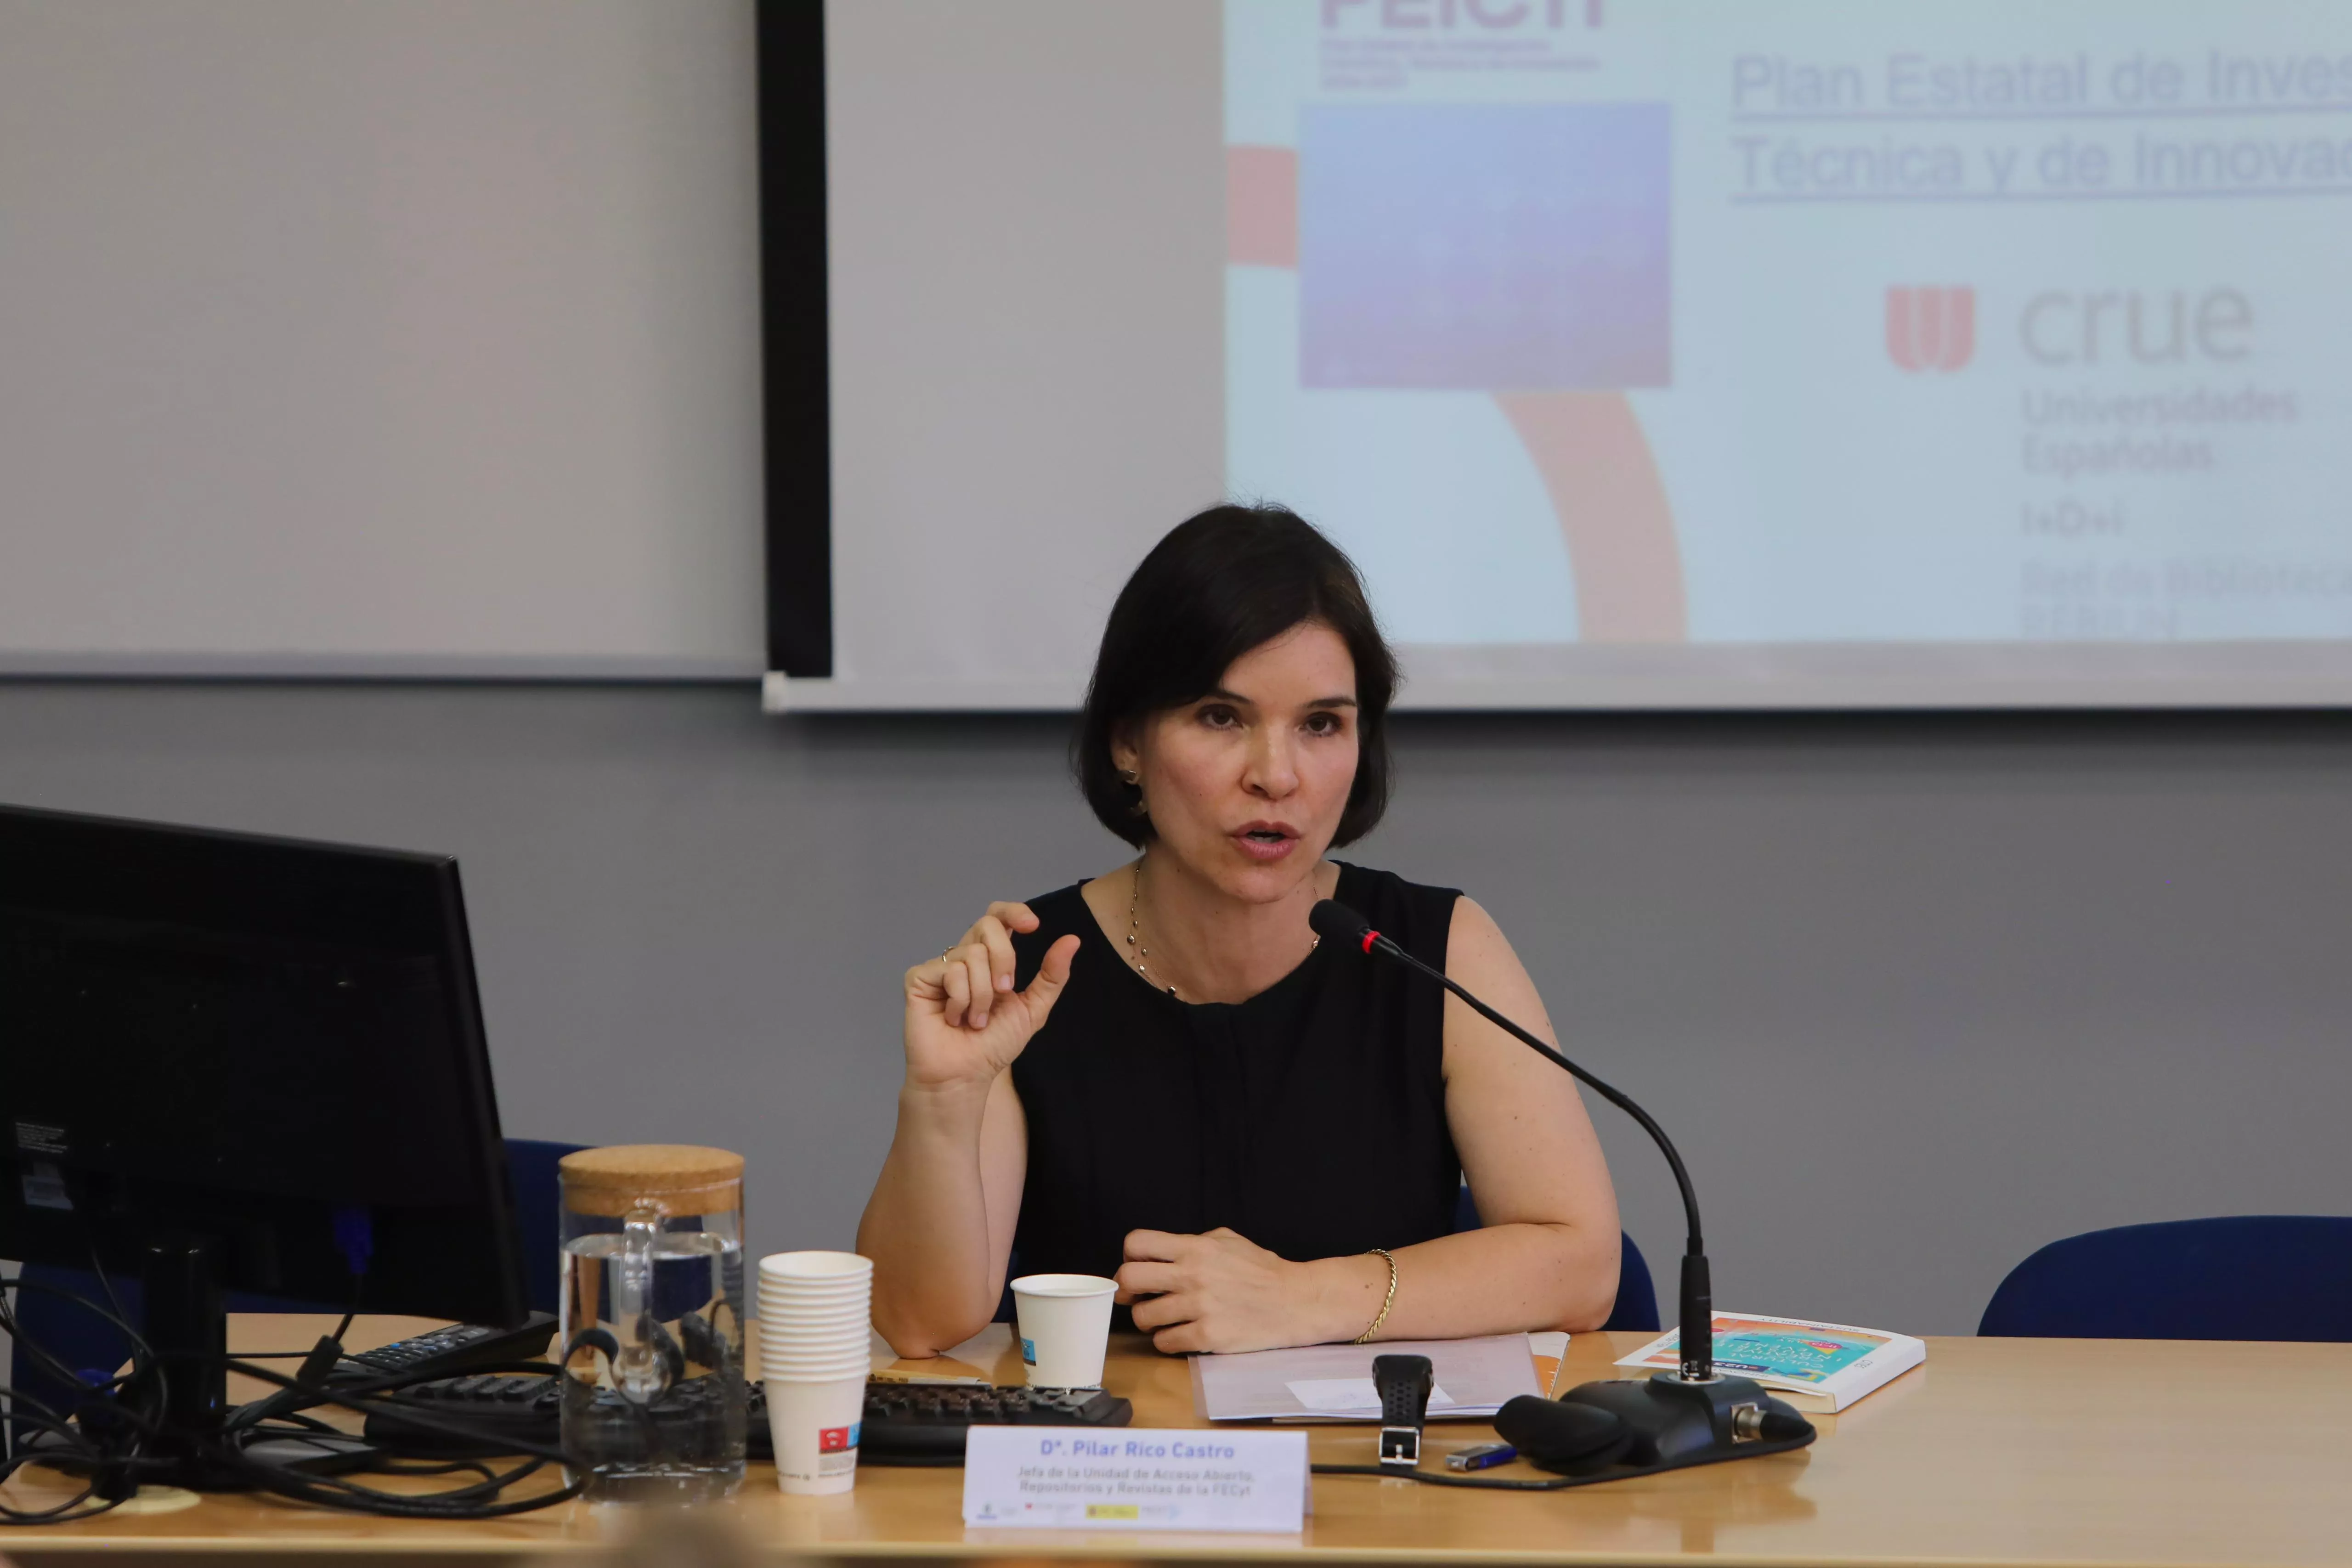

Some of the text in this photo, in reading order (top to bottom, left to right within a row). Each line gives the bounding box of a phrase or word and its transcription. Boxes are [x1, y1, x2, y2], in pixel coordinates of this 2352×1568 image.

[1732, 54, 1864, 107] Plan
[1886, 53, 2088, 106] Estatal
[2109, 48, 2185, 105] de
[1729, 135, 1964, 189] Técnica
[1984, 146, 2018, 197] y
[2035, 134, 2112, 186] de
[2019, 284, 2255, 367] crue
[2020, 385, 2299, 425] Universidades
[2020, 433, 2216, 482] Españolas
[1730, 1352, 1823, 1369] CULTURAL
[1073, 1439, 1118, 1457] Pilar
[1125, 1441, 1166, 1458] Rico
[1172, 1442, 1235, 1459] Castro
[1018, 1466, 1045, 1480] Jefa
[1047, 1467, 1063, 1479] de
[1067, 1467, 1080, 1478] la
[1083, 1468, 1129, 1480] Unidad
[1132, 1468, 1149, 1480] de
[1153, 1469, 1199, 1481] Acceso
[1019, 1481, 1103, 1496] Repositorios
[1106, 1484, 1114, 1495] y
[1117, 1482, 1173, 1495] Revistas
[1176, 1483, 1193, 1496] de
[1196, 1483, 1209, 1496] la
